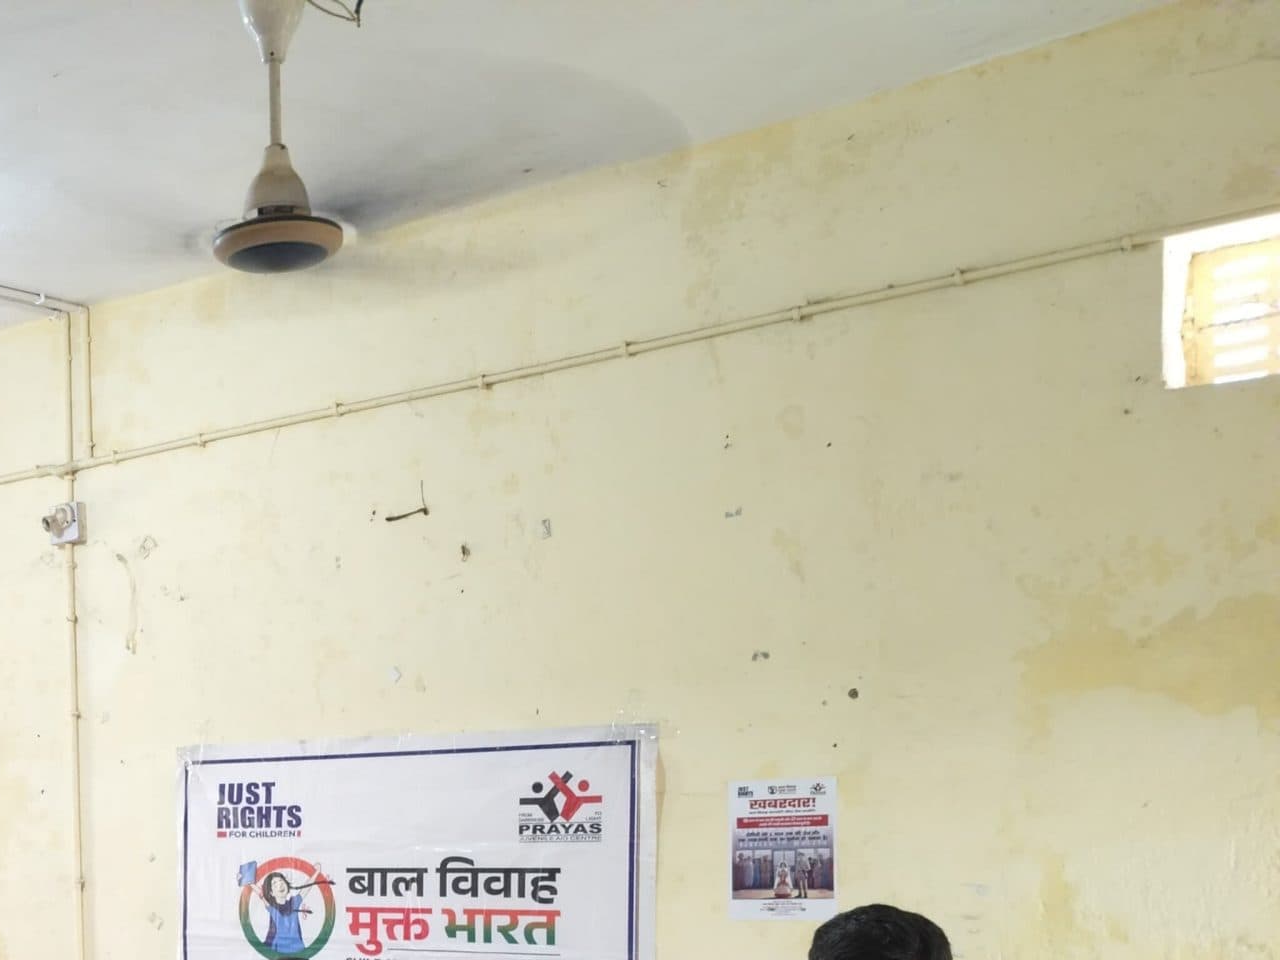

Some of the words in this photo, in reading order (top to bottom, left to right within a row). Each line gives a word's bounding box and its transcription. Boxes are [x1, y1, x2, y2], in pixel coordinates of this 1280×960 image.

[217, 782, 275, 805] JUST
[217, 805, 302, 829] RIGHTS
[519, 823, 602, 834] PRAYAS
[249, 830, 296, 838] CHILDREN
[346, 867, 428, 897] बाल
[435, 856, 561, 904] विवाह
[345, 906, 432, 956] मुक्त
[441, 908, 561, 946] भारत
